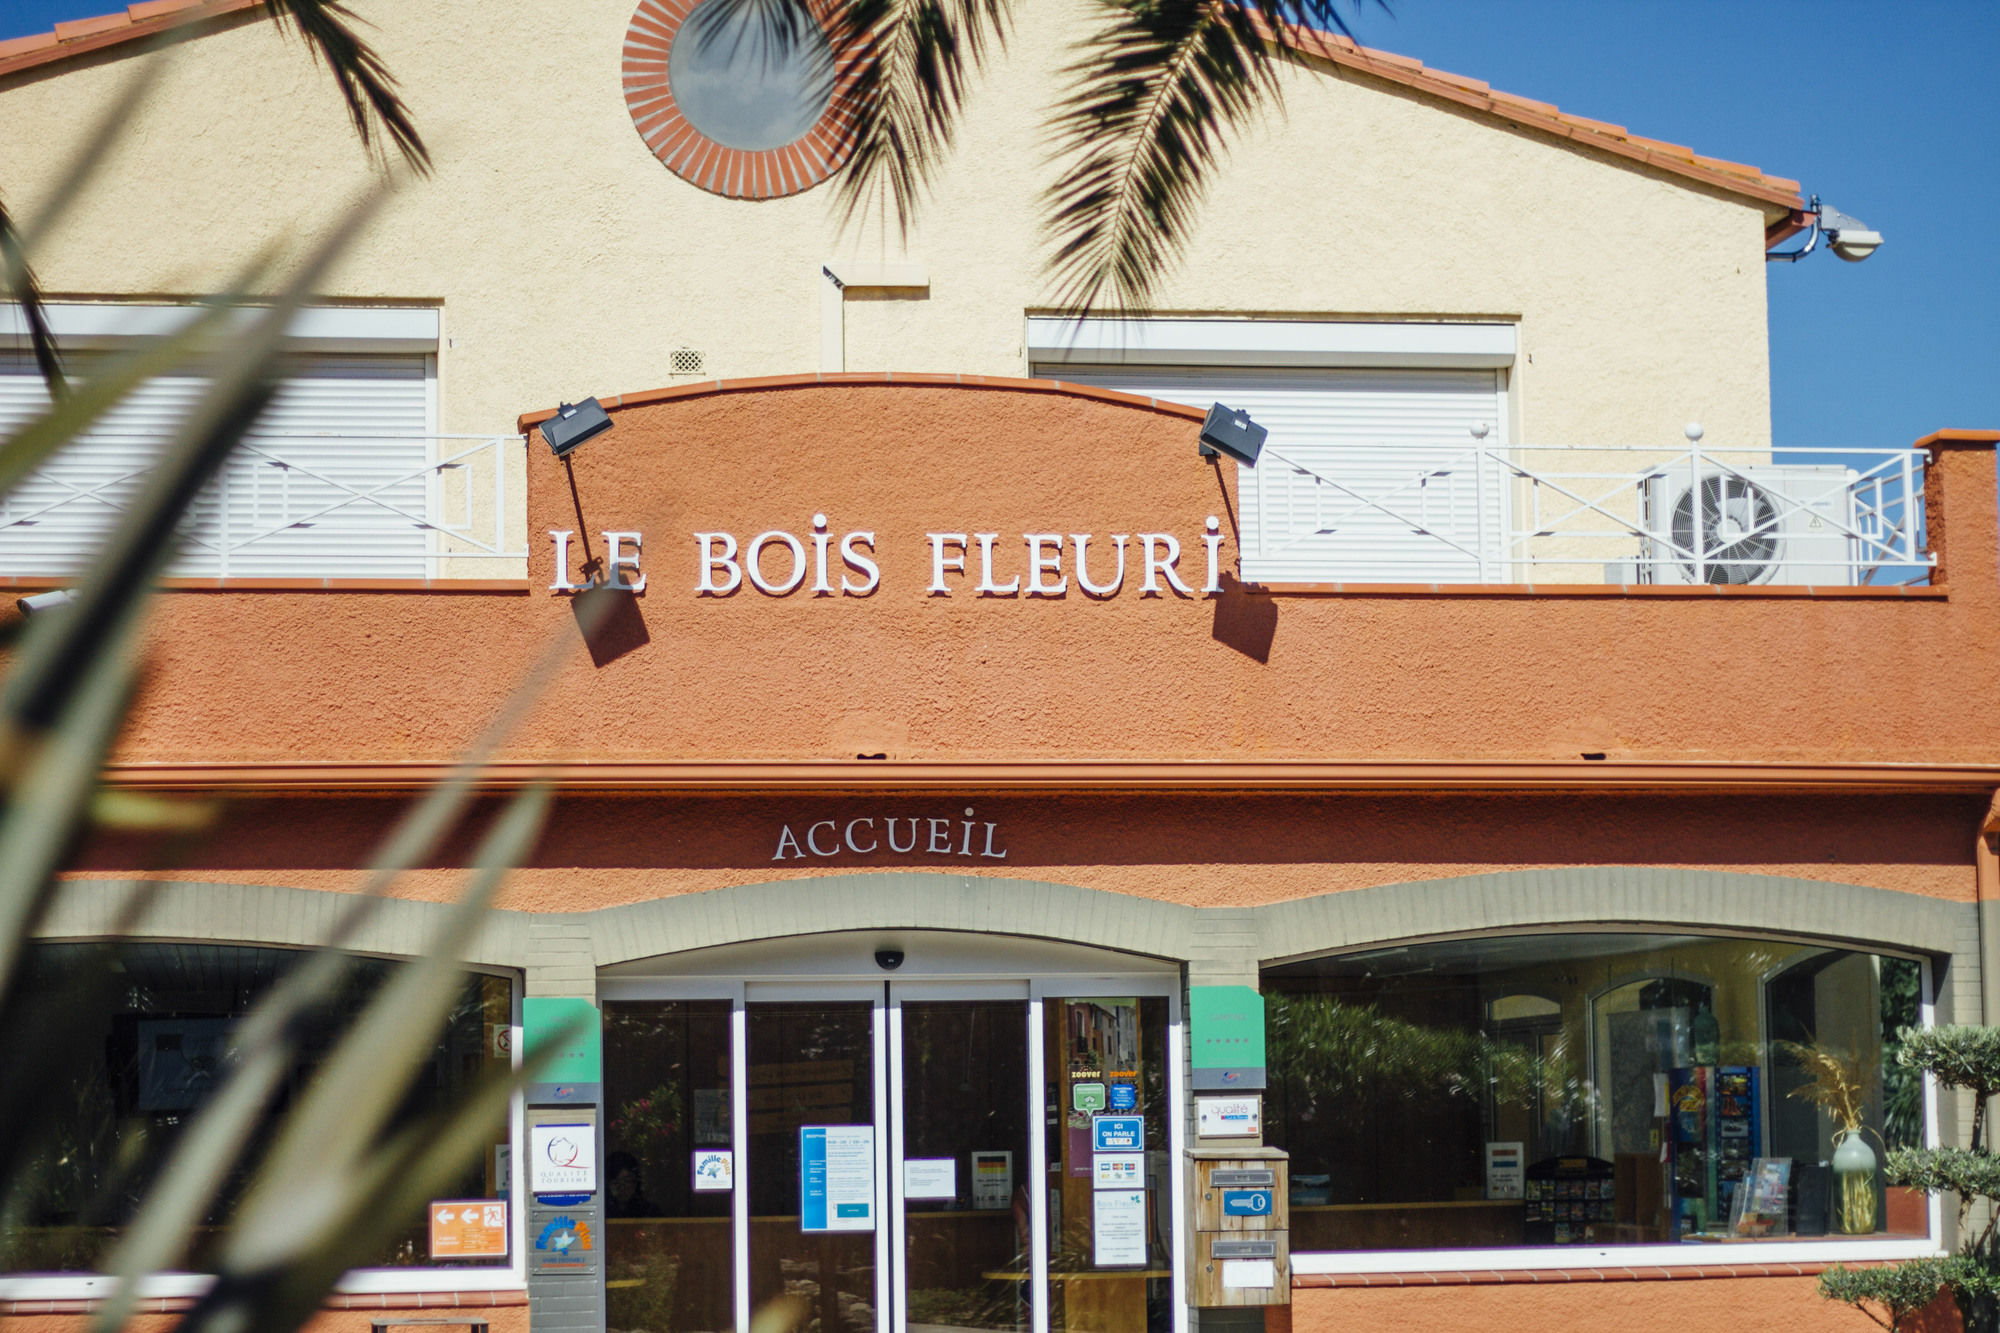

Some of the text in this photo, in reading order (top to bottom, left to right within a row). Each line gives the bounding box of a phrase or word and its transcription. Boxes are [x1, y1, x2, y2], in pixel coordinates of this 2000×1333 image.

[549, 530, 647, 591] LE
[1109, 1070, 1137, 1078] zoover
[1211, 1104, 1248, 1116] qualité
[697, 1154, 721, 1175] Famille
[535, 1215, 577, 1249] Famille
